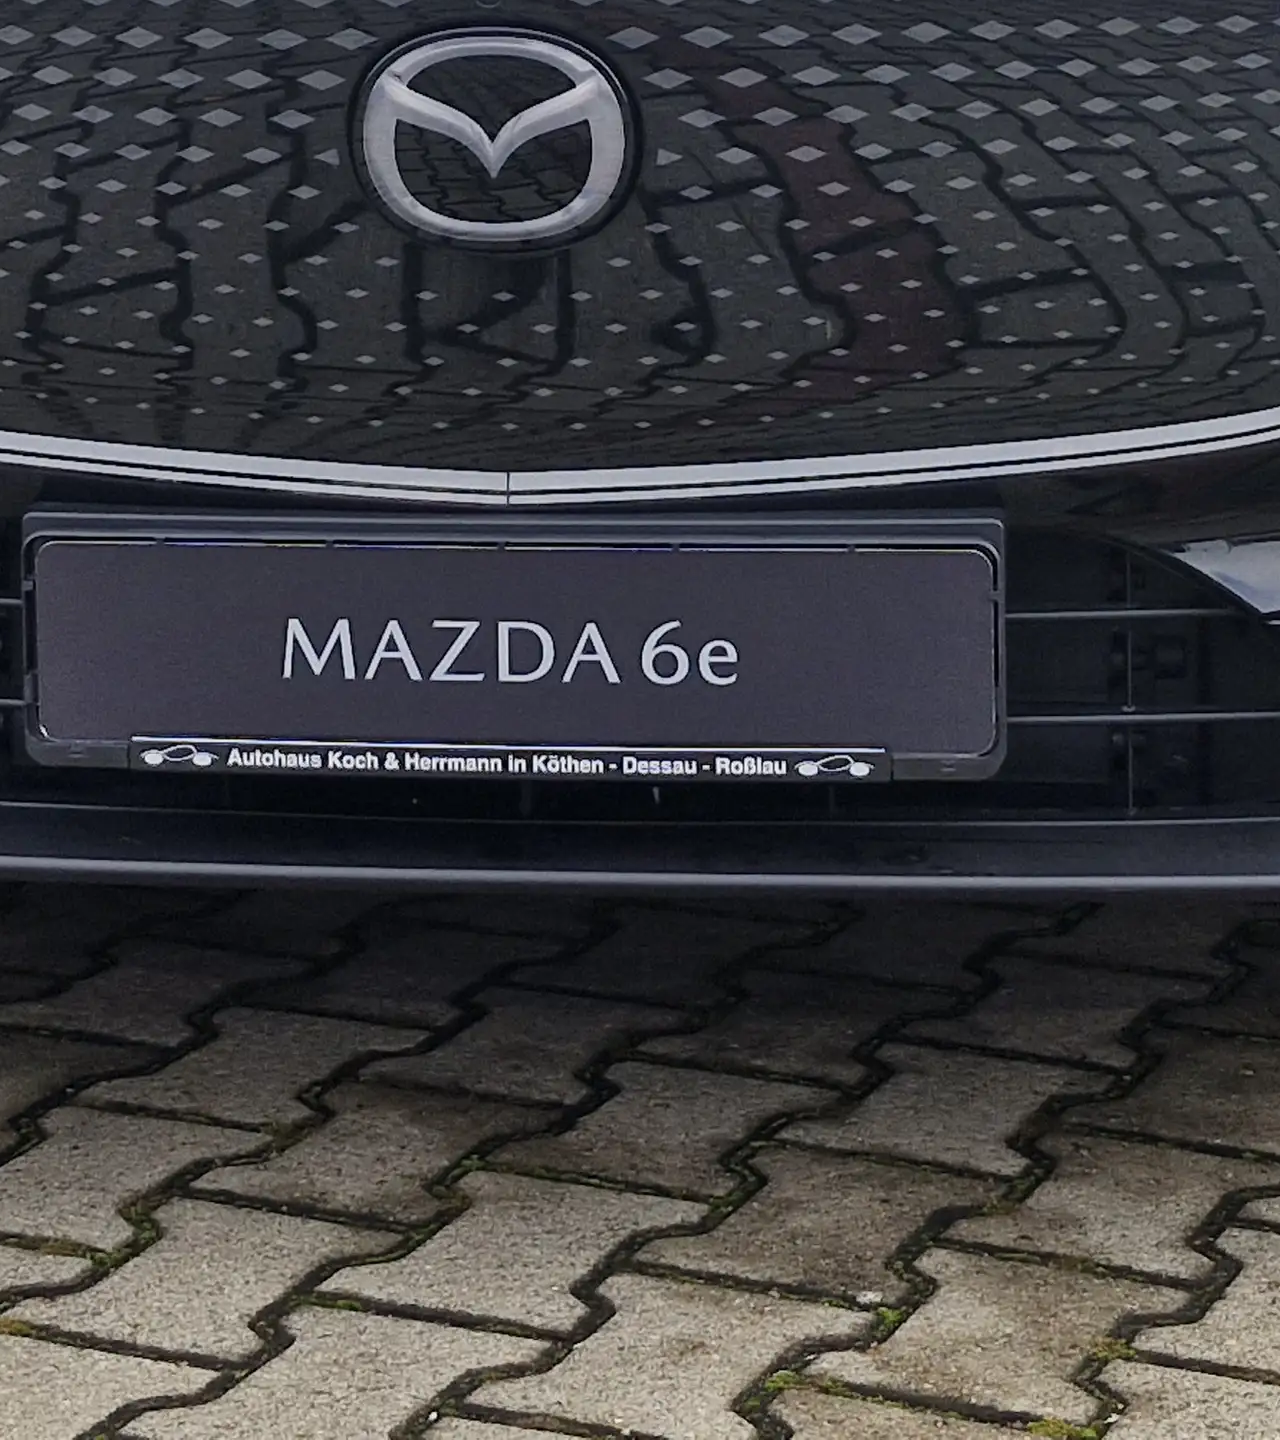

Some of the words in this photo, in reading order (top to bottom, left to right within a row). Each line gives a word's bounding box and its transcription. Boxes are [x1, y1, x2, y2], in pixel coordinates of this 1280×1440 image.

[282, 617, 621, 684] MAZDA
[641, 619, 739, 685] 6e
[226, 747, 322, 768] Autohaus
[328, 750, 380, 770] Koch
[384, 751, 400, 771] &
[405, 752, 503, 773] Herrmann
[507, 754, 527, 773] in
[532, 754, 605, 775] Köthen
[622, 756, 698, 776] Dessau
[715, 756, 787, 776] Roßlau
